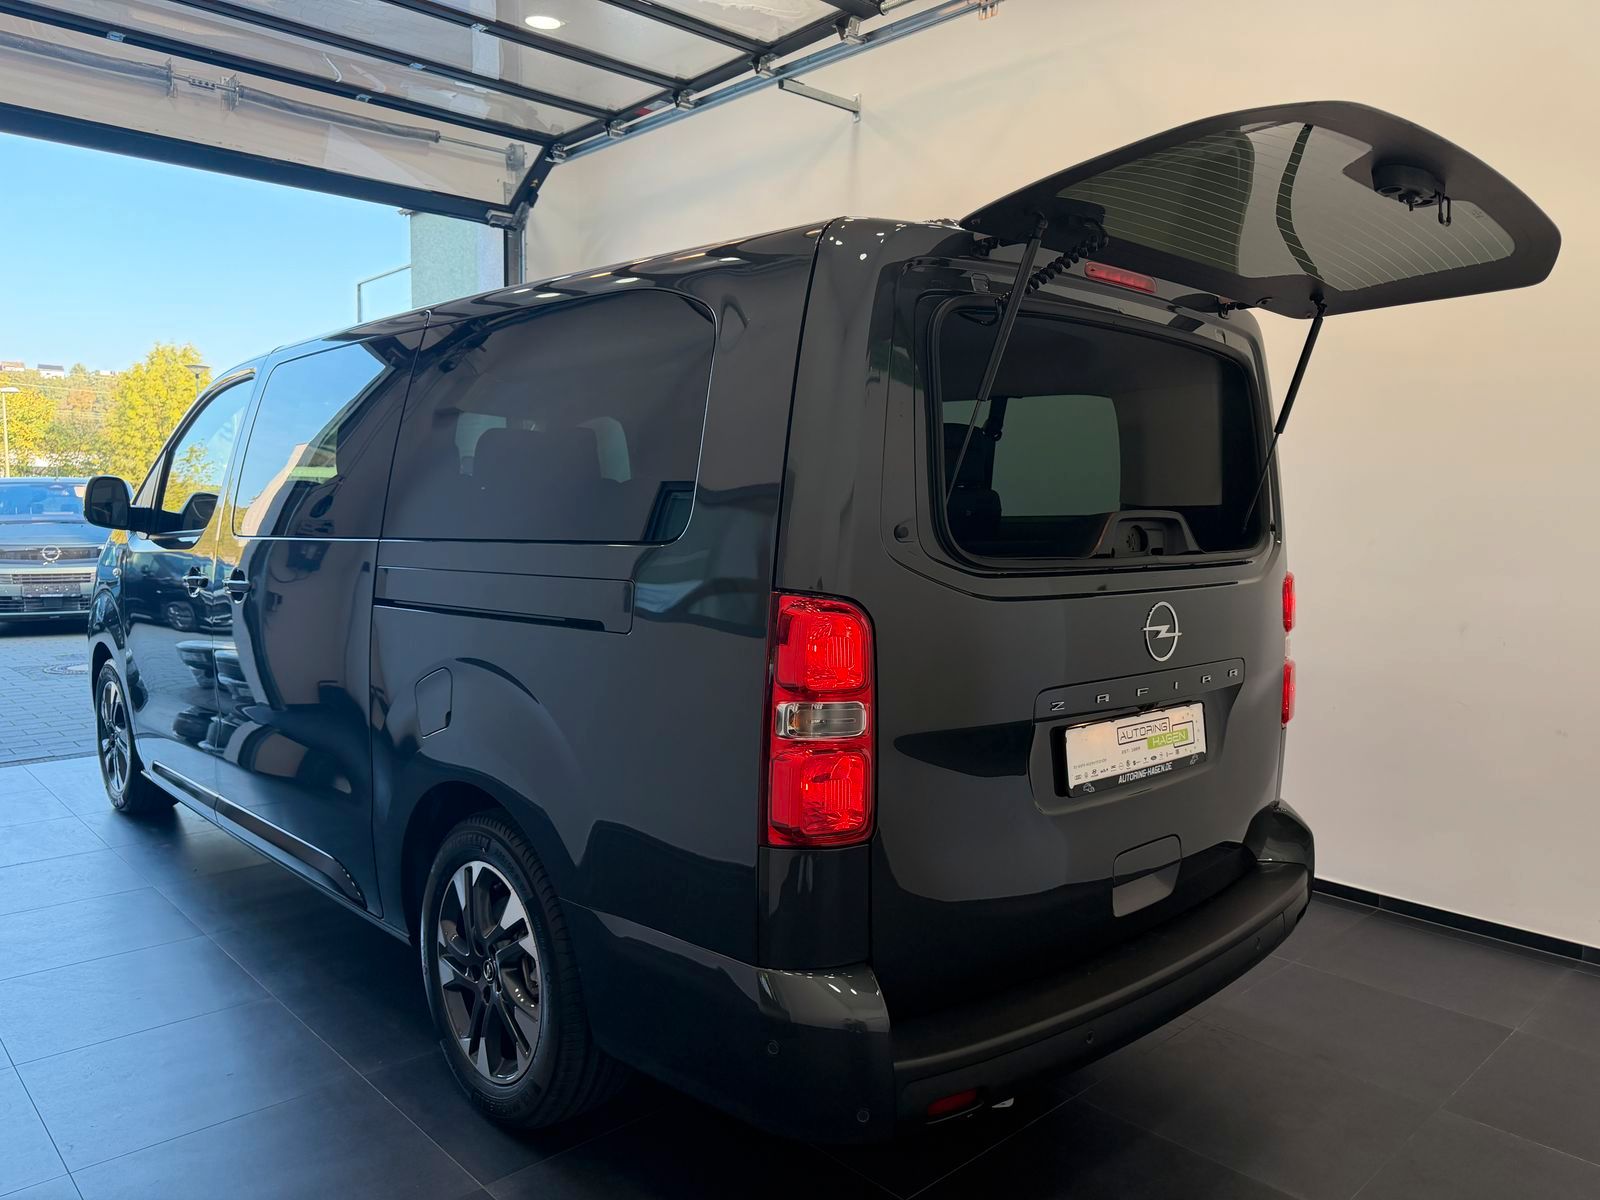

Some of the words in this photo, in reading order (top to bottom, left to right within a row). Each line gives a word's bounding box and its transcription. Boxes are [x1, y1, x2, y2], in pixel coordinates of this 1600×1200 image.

[1051, 668, 1239, 711] ZAFIRA
[1120, 722, 1168, 741] AUTORING
[1152, 731, 1186, 747] HAGEN
[1118, 762, 1173, 784] AUTORING-HAGEN.DE
